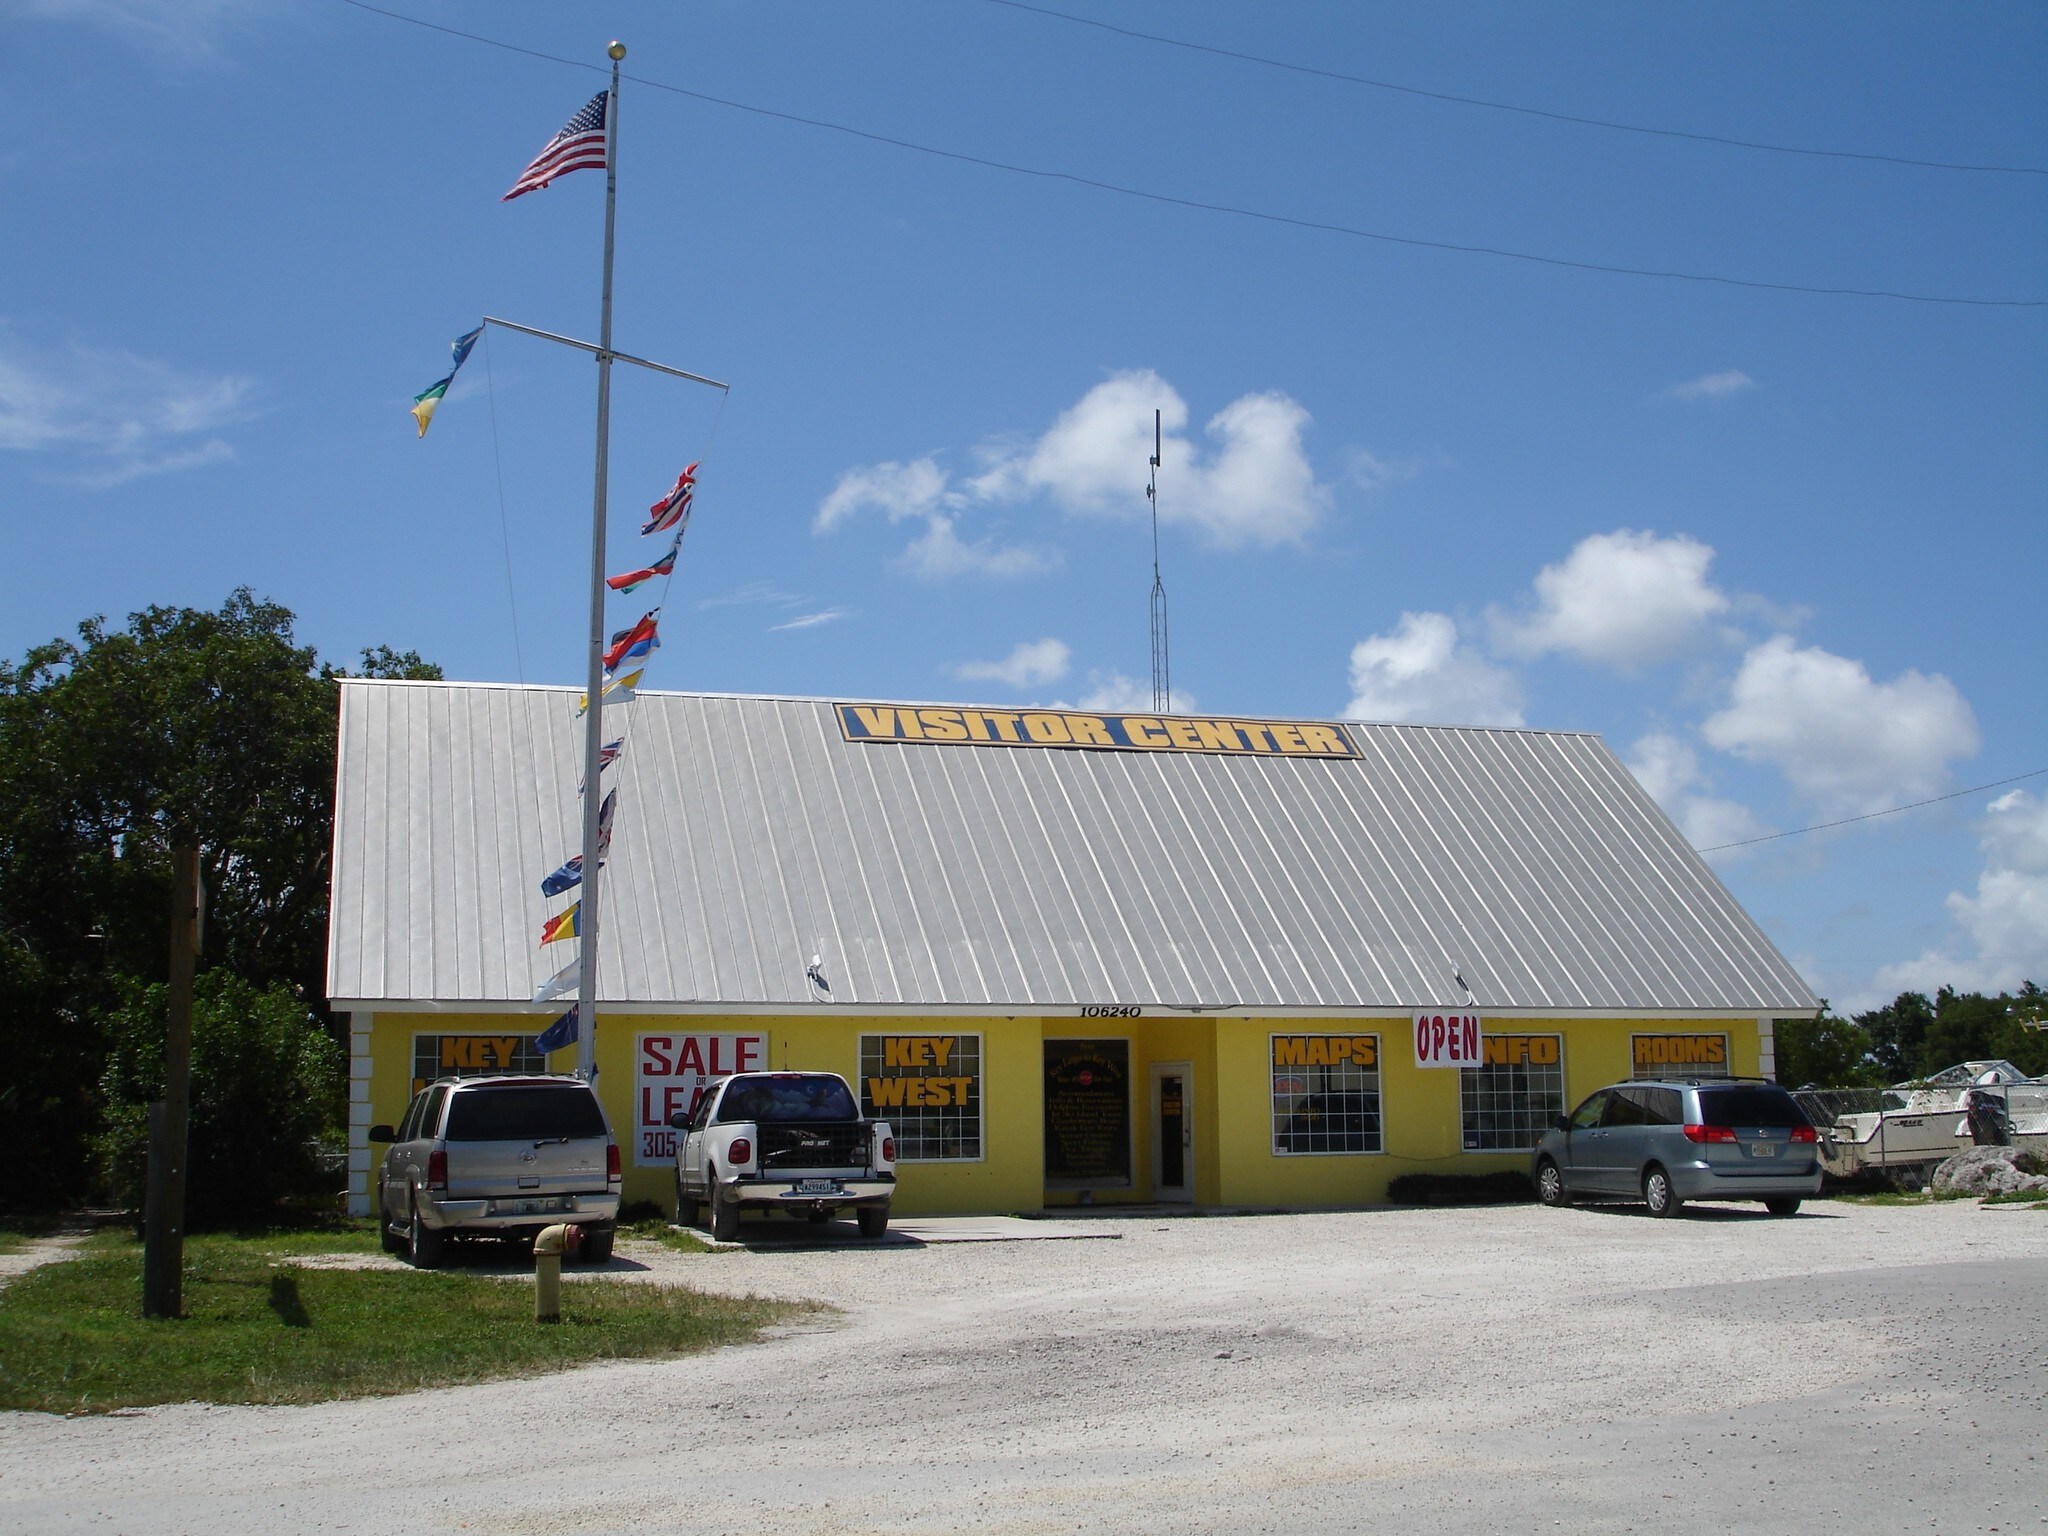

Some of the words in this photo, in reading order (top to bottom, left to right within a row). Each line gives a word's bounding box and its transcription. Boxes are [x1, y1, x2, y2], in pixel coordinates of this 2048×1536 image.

[853, 706, 1114, 745] VISITOR
[1121, 717, 1349, 754] CENTER
[1080, 1006, 1141, 1018] 106240
[441, 1036, 519, 1068] KEY
[884, 1036, 955, 1068] KEY
[1274, 1037, 1375, 1066] MAPS
[1417, 1015, 1477, 1062] OPEN
[1482, 1037, 1558, 1065] NFO
[1635, 1036, 1724, 1064] ROOMS
[643, 1036, 760, 1076] SALE
[696, 1077, 707, 1086] OR
[868, 1076, 973, 1107] WEST
[642, 1087, 705, 1126] LEA
